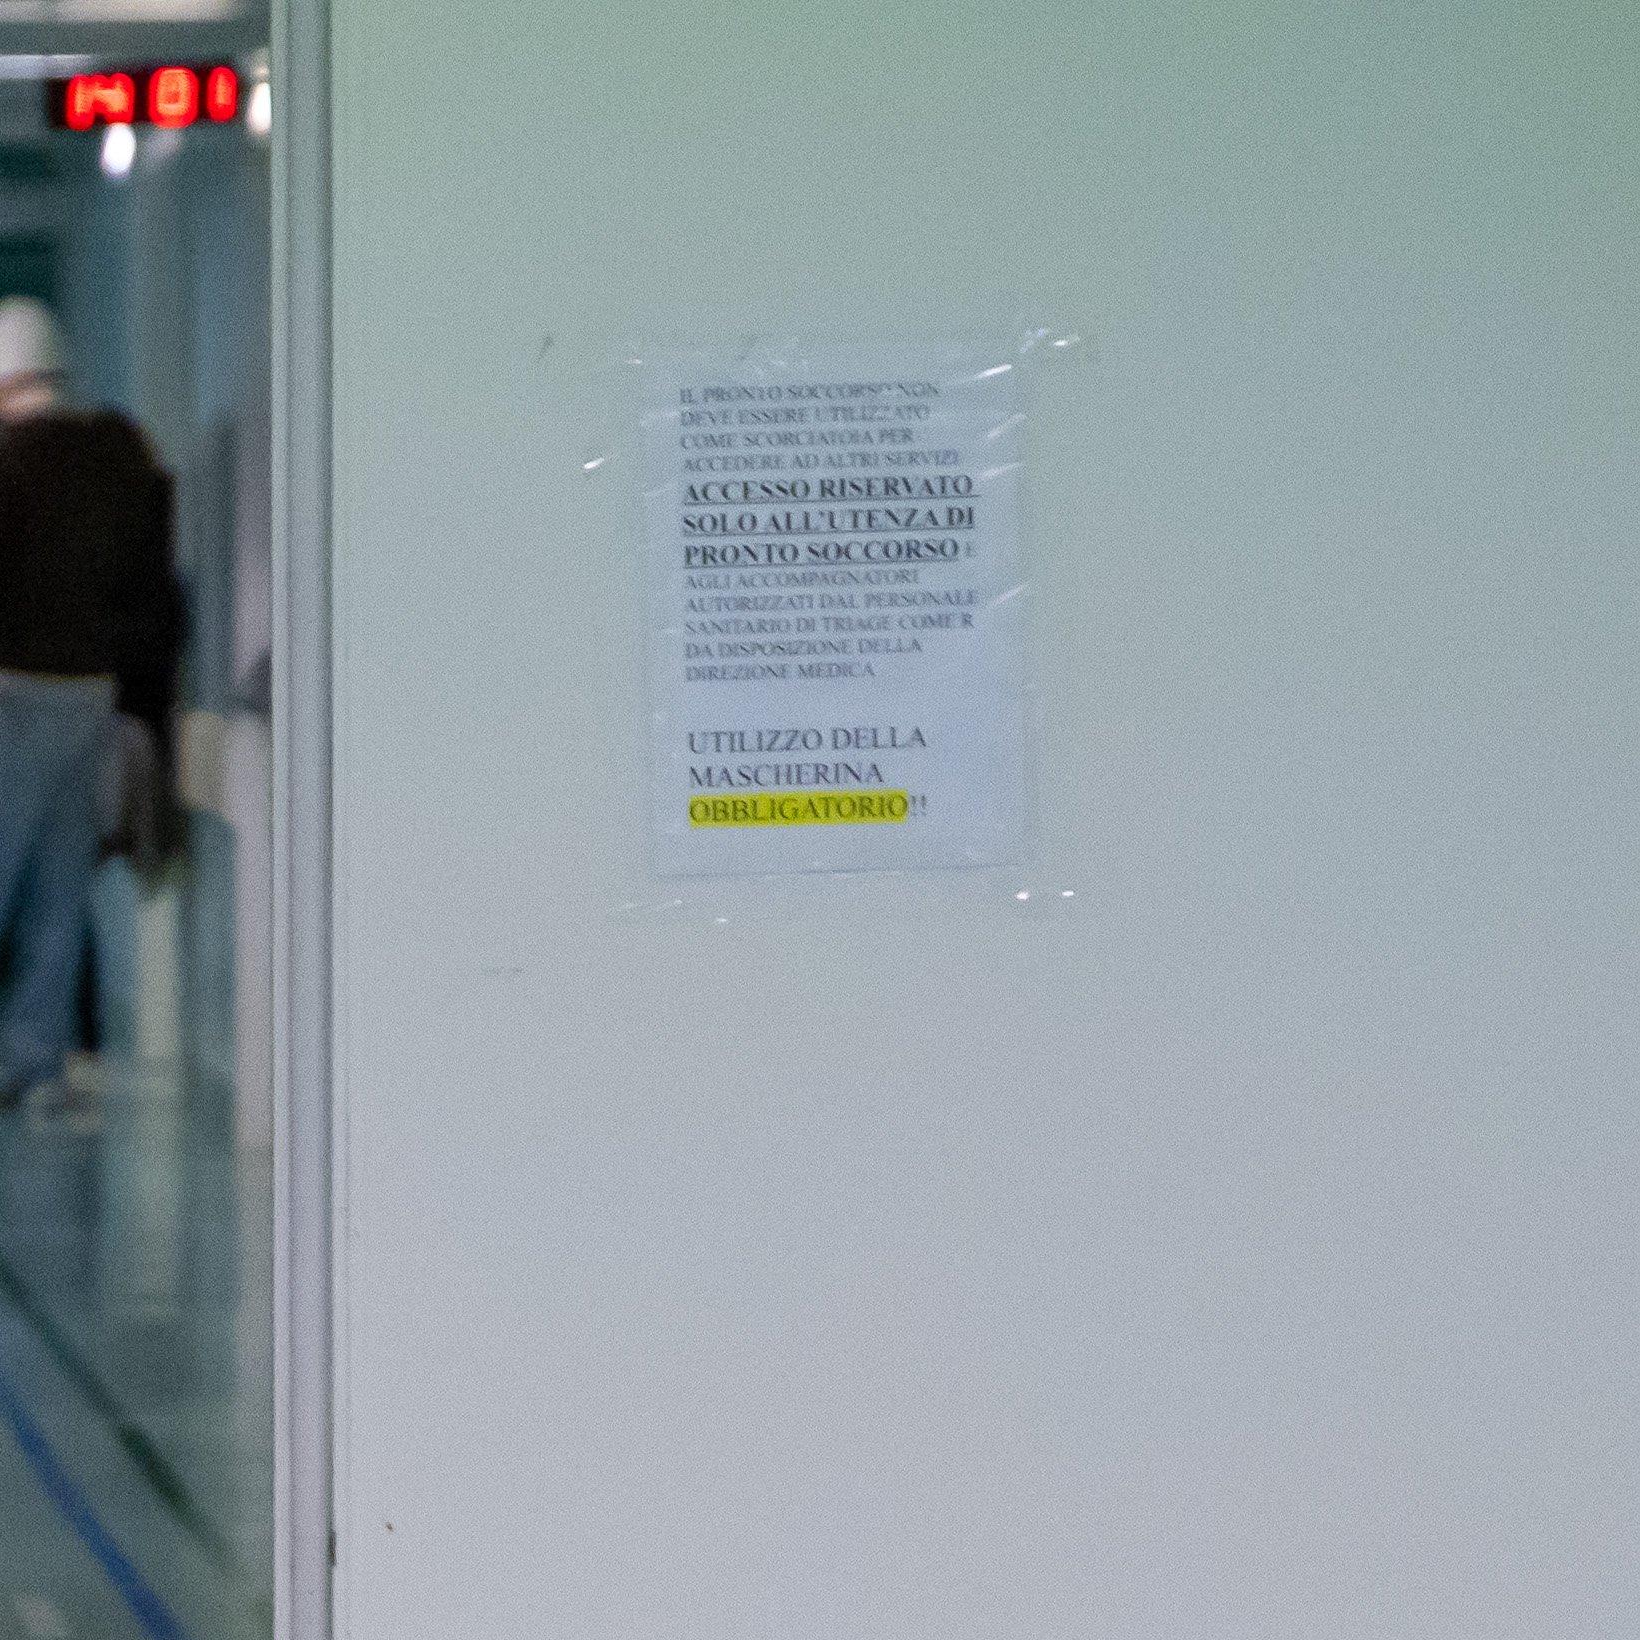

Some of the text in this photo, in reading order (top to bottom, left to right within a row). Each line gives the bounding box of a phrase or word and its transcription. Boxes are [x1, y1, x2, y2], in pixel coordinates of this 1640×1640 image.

[703, 385, 782, 403] PRONTO
[680, 407, 733, 427] DEVE
[738, 405, 812, 425] ESSERE
[680, 427, 914, 449] COME SCORCIATOIA PER
[683, 449, 960, 472] ACCEDERE AD ALTRI SERVIZI
[683, 474, 973, 502] ACCESSO RISERVATO
[682, 512, 758, 534] SOLO
[946, 506, 974, 529] DI
[684, 542, 800, 566] PRONTO
[806, 537, 959, 562] SOCCORSO
[685, 569, 919, 589] AGLI ACCOMPAGNATORI
[685, 589, 979, 612] AUTORIZZATI DAL PERSONALE
[684, 616, 791, 635] SANITARIO
[796, 616, 816, 632] DI
[821, 615, 891, 632] TRIAGE
[897, 613, 955, 630] COME
[685, 637, 923, 659] DA DISPOSIZIONE DELLA
[685, 661, 876, 682] DIREZIONE MEDICA
[688, 726, 927, 753] UTILIZZO DELLA
[689, 763, 885, 787] MASCHERINA
